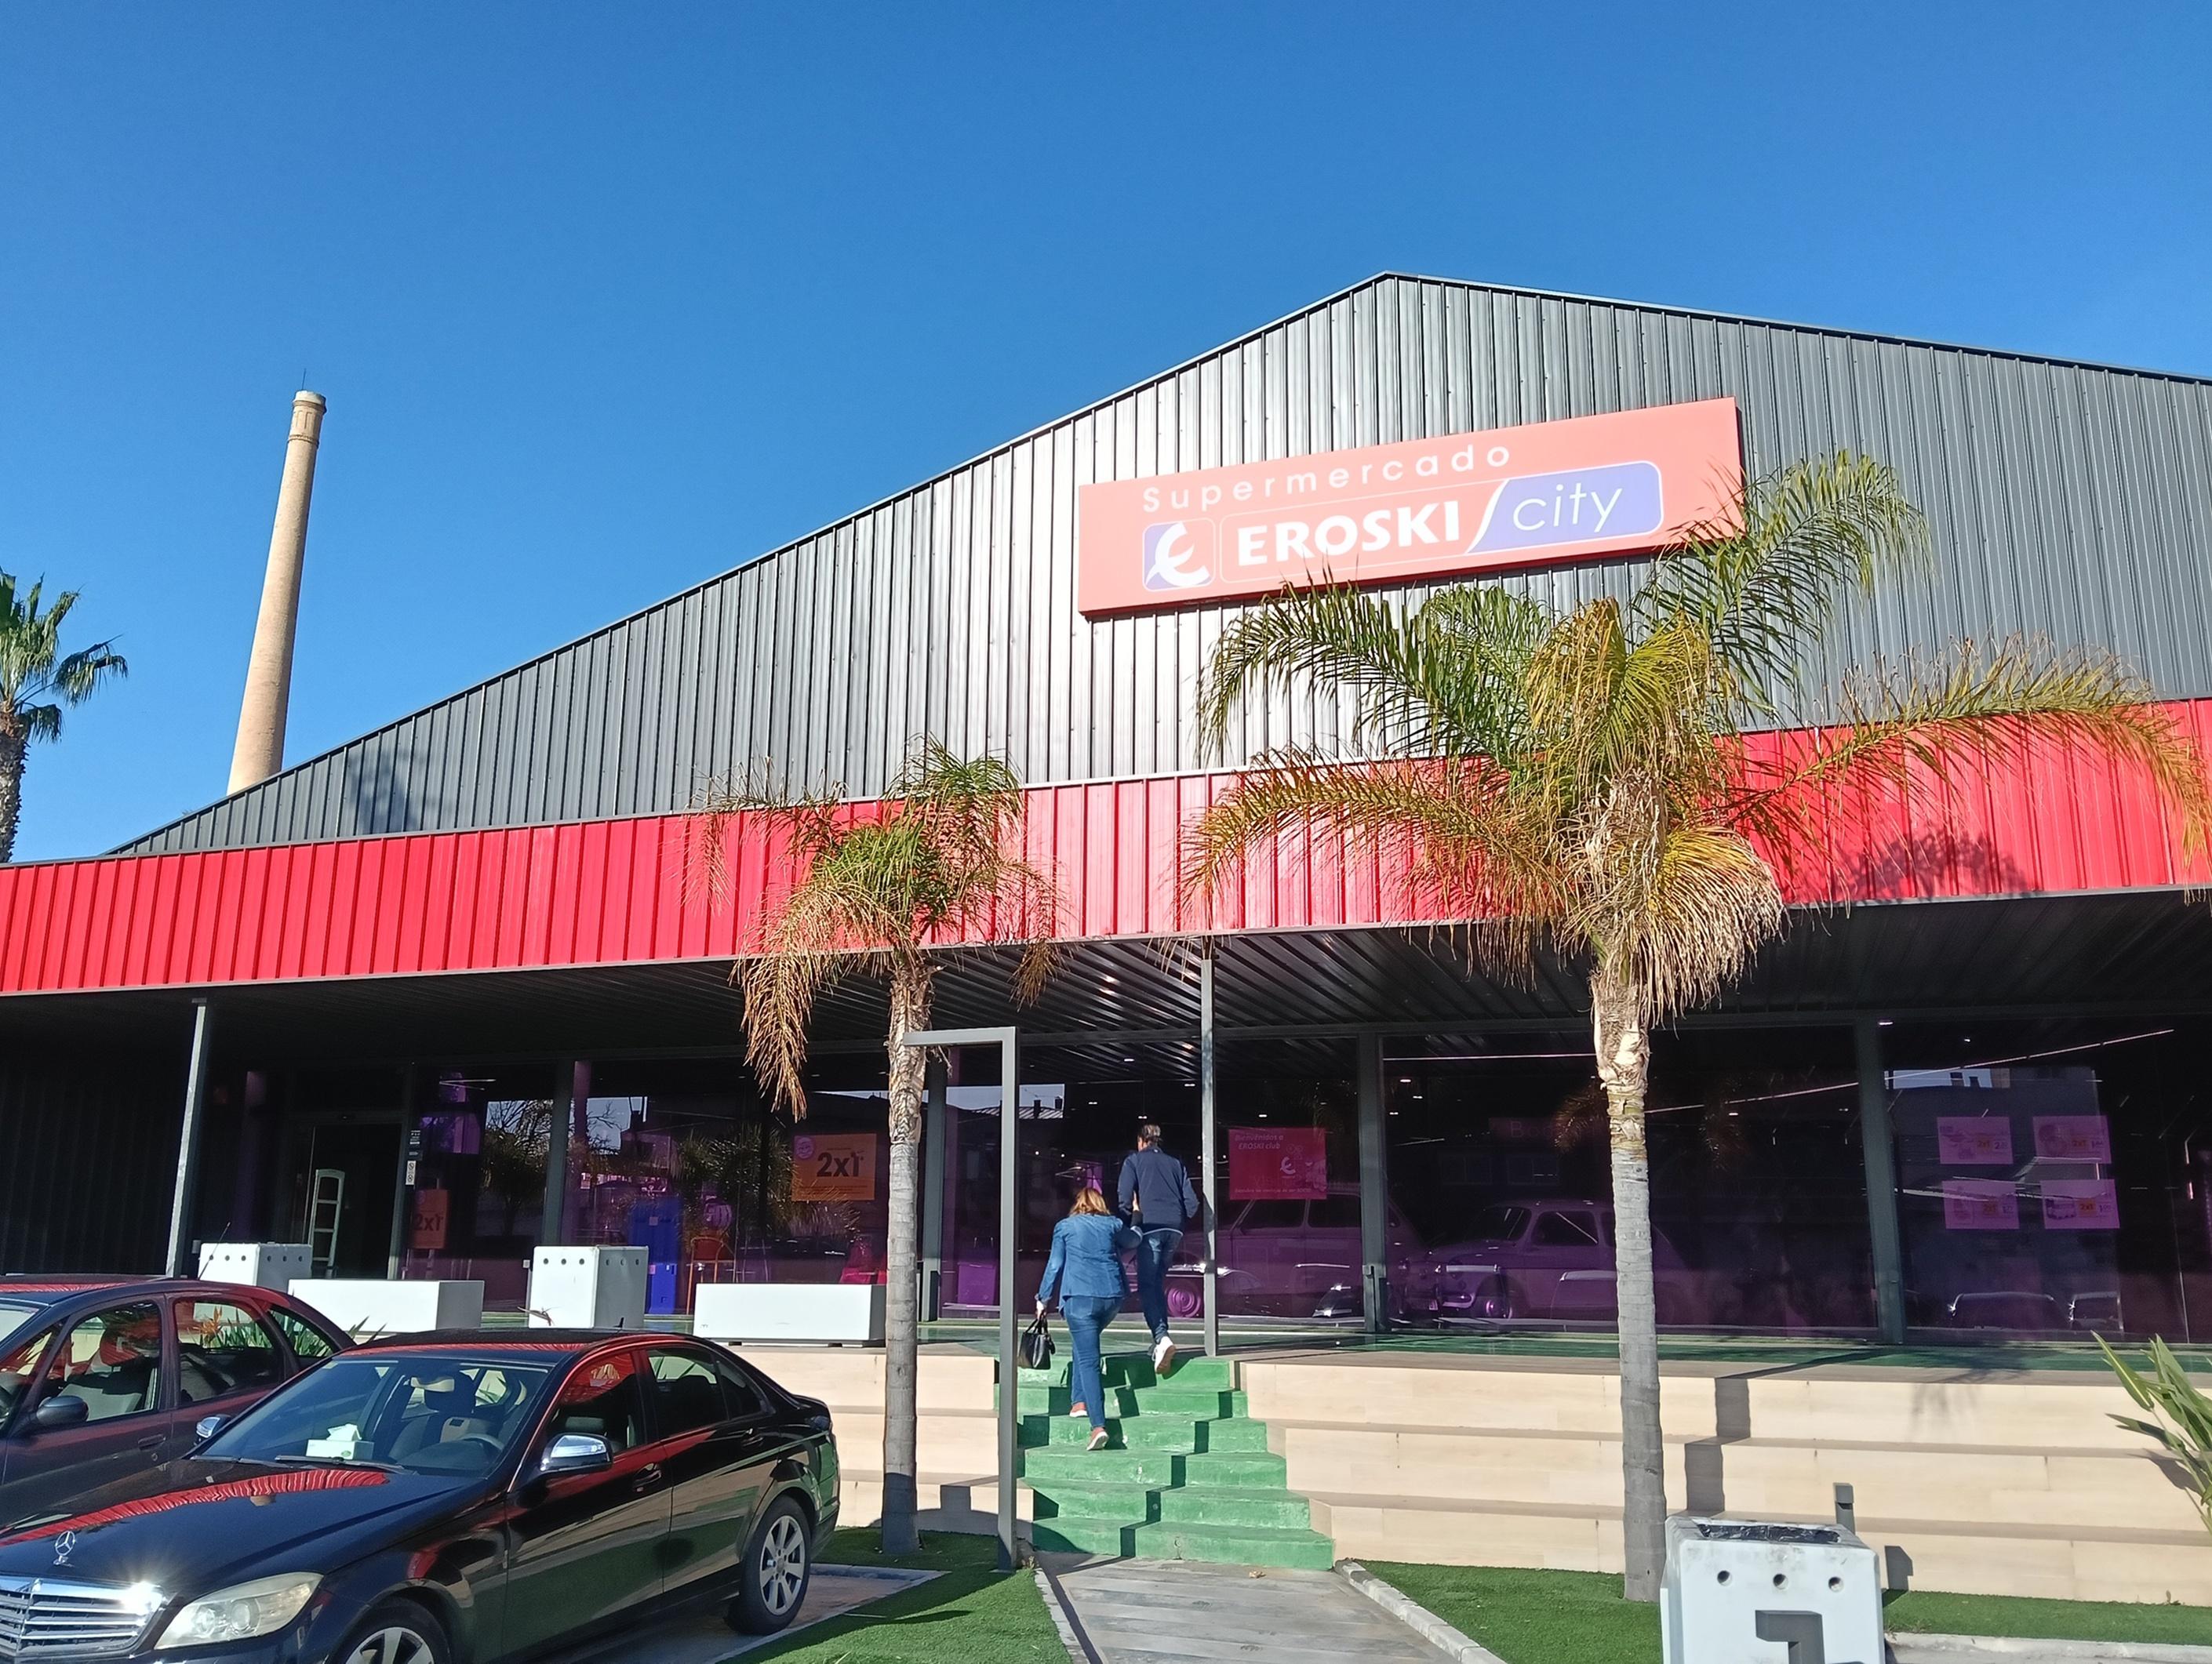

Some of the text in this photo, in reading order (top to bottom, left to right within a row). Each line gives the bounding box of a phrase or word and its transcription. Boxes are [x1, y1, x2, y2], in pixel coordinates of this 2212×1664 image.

[1142, 444, 1510, 513] Supermercado
[1237, 482, 1624, 567] EROSKI city
